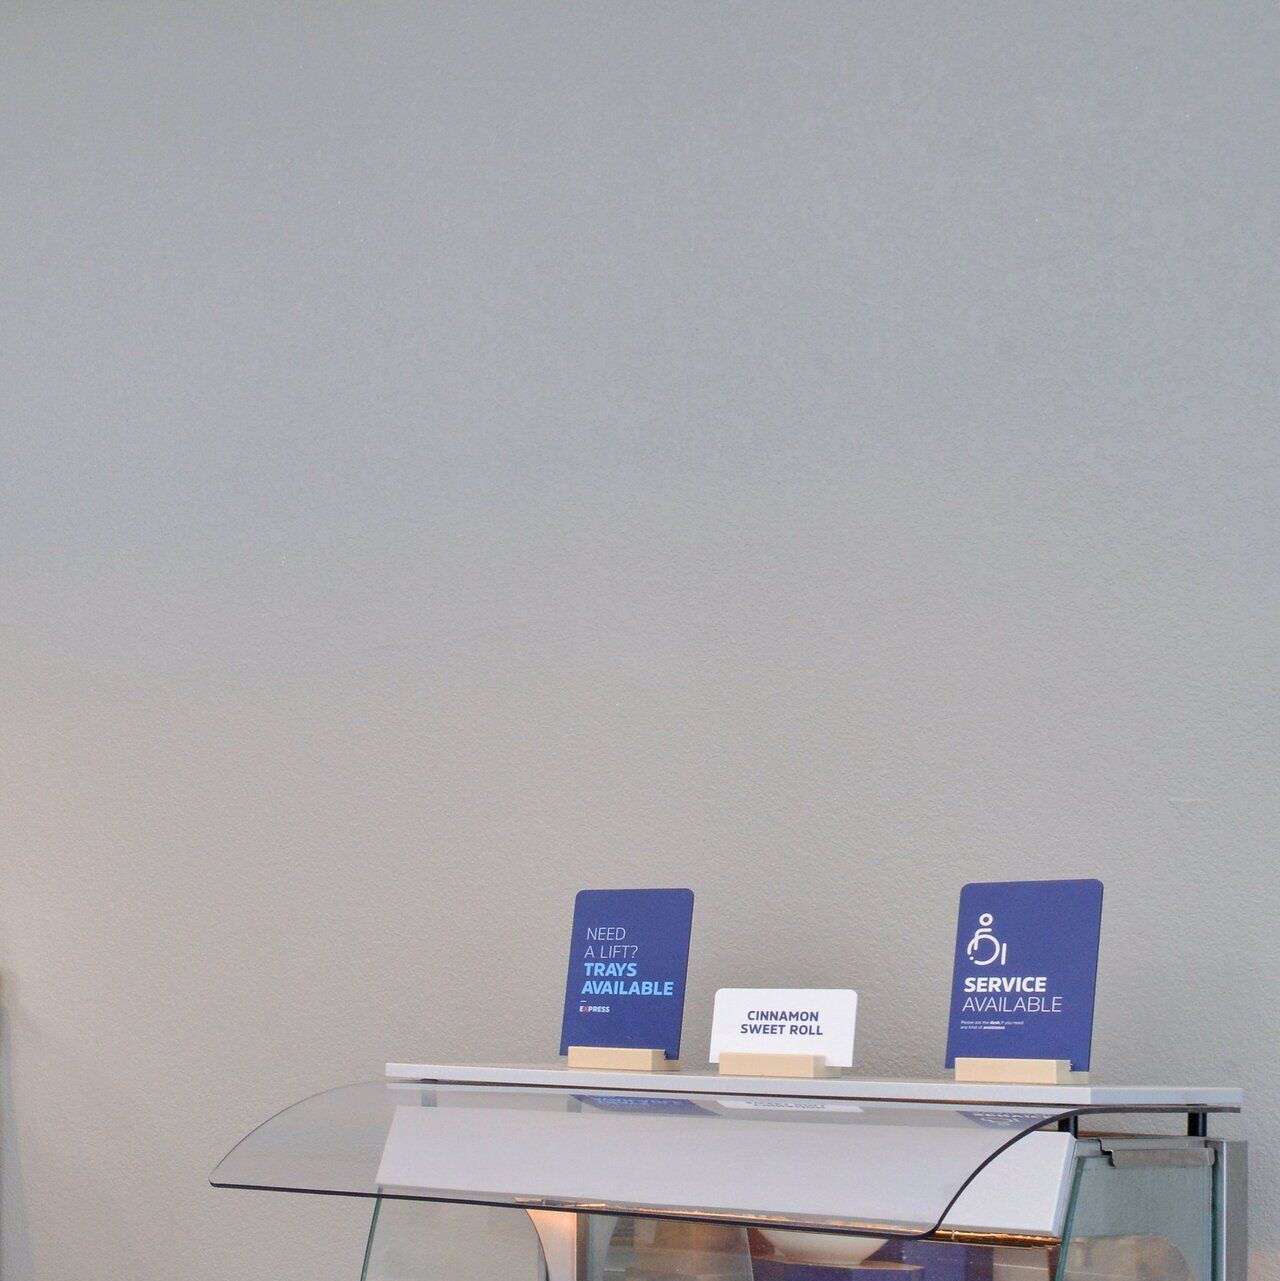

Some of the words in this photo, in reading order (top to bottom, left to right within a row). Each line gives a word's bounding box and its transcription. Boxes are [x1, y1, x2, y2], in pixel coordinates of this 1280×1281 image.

[586, 927, 626, 941] NEED
[584, 945, 595, 959] A
[600, 945, 639, 959] LIFT?
[584, 962, 638, 977] TRAYS
[581, 980, 674, 996] AVAILABLE
[963, 976, 1047, 993] SERVICE
[579, 1005, 610, 1013] EXPRESS
[961, 996, 1063, 1012] AVAILABLE
[747, 1010, 819, 1022] CINNAMON
[740, 1023, 786, 1035] SWEET
[789, 1024, 823, 1036] ROLL
